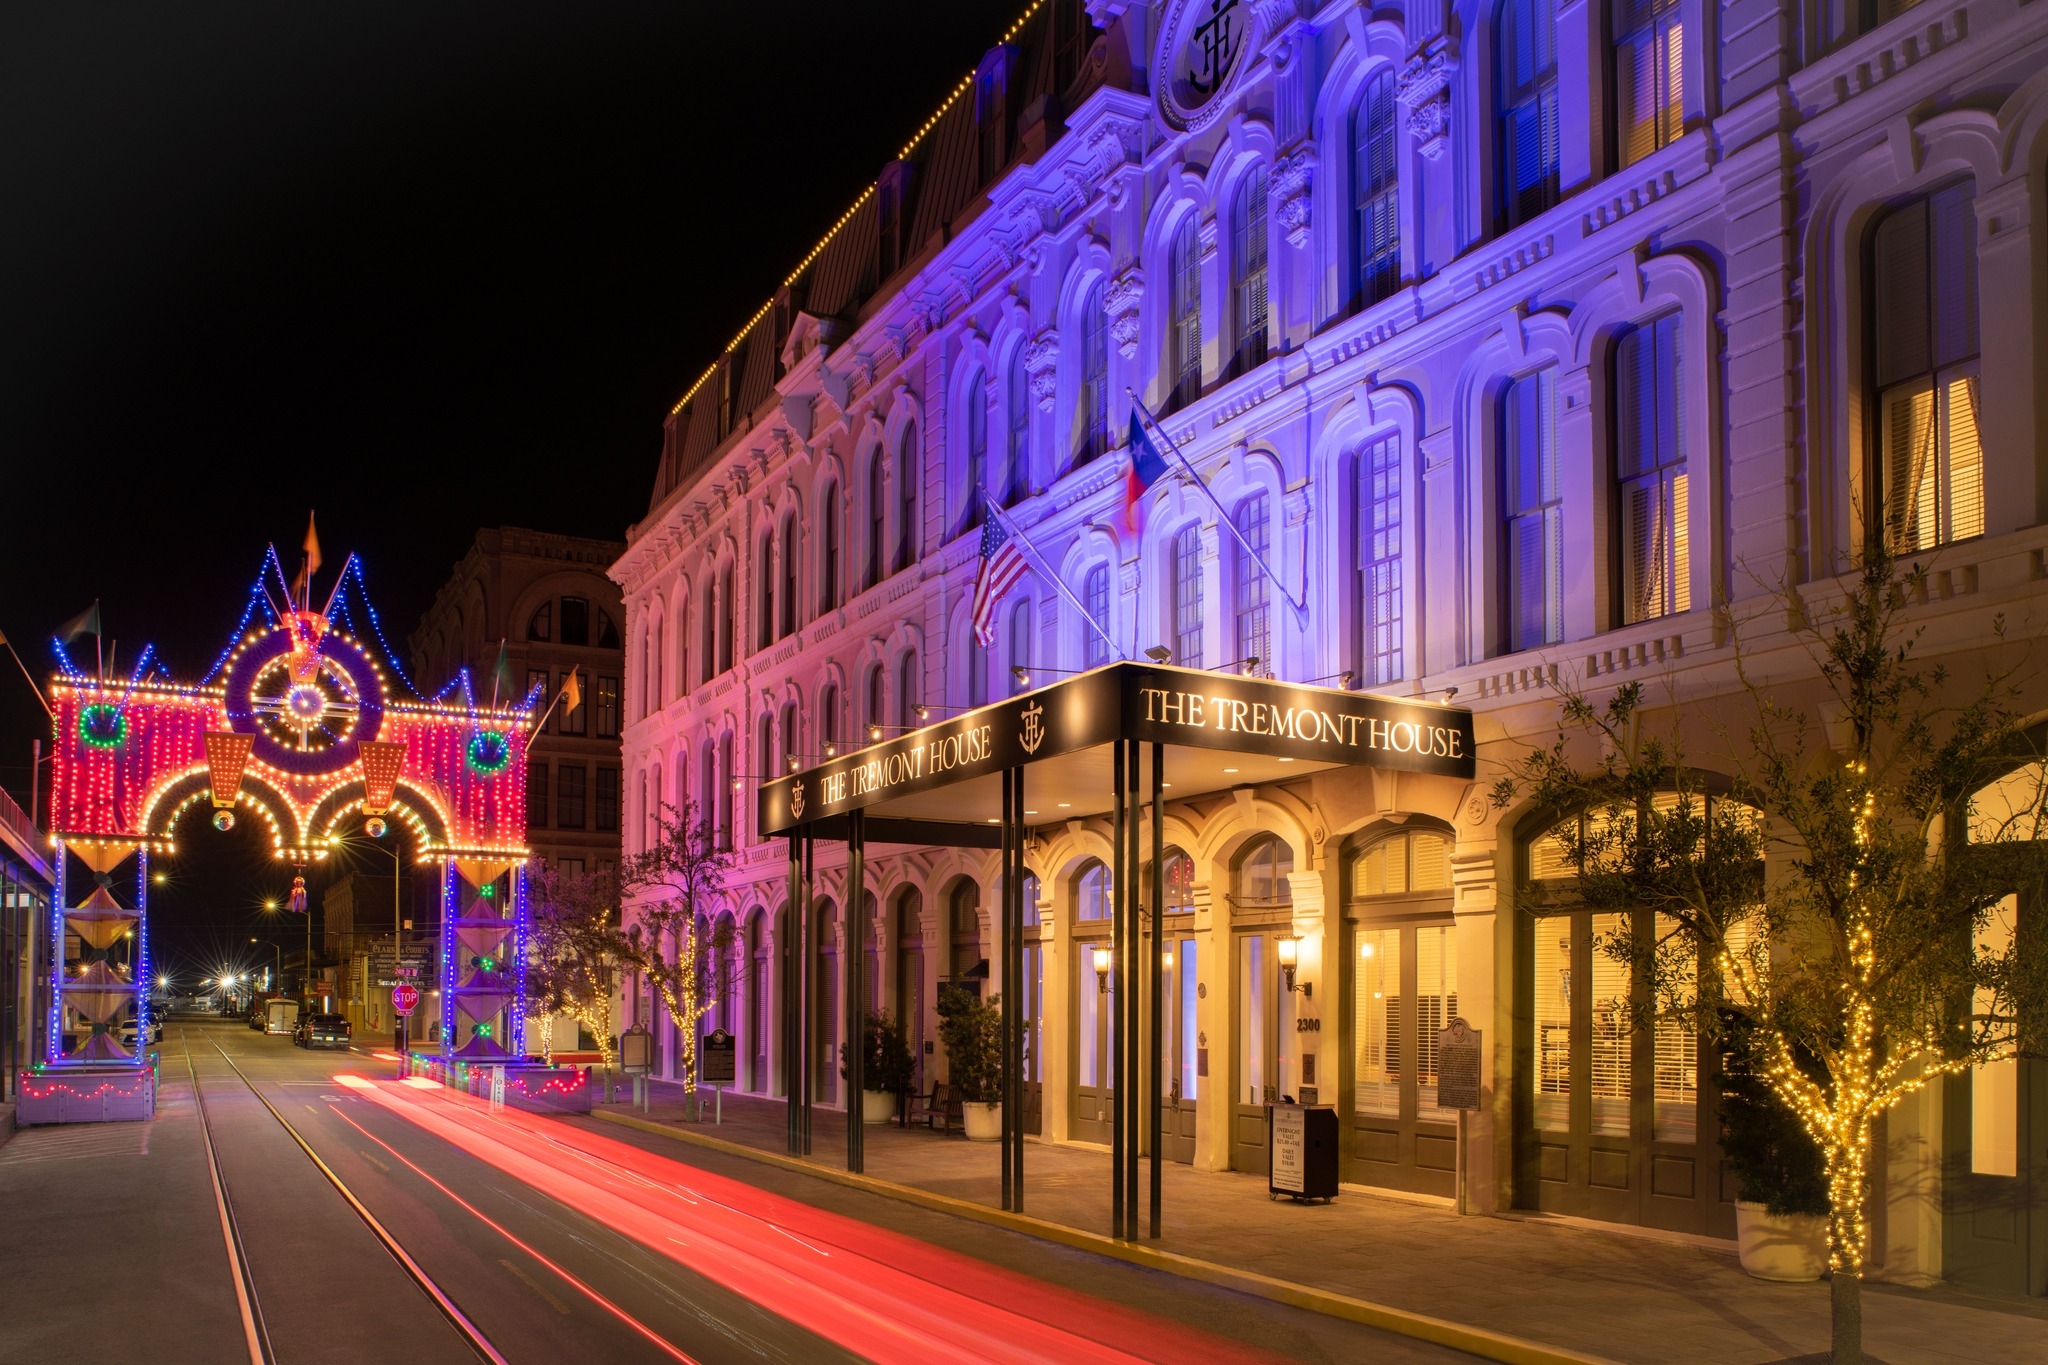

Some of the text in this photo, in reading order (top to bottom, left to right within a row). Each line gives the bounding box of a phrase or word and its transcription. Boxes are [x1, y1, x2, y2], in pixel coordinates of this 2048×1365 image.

[1139, 688, 1463, 759] THE TREMONT HOUSE
[821, 725, 992, 805] THE TREMONT HOUSE
[394, 992, 416, 1002] STOP
[1297, 1018, 1320, 1032] 2300
